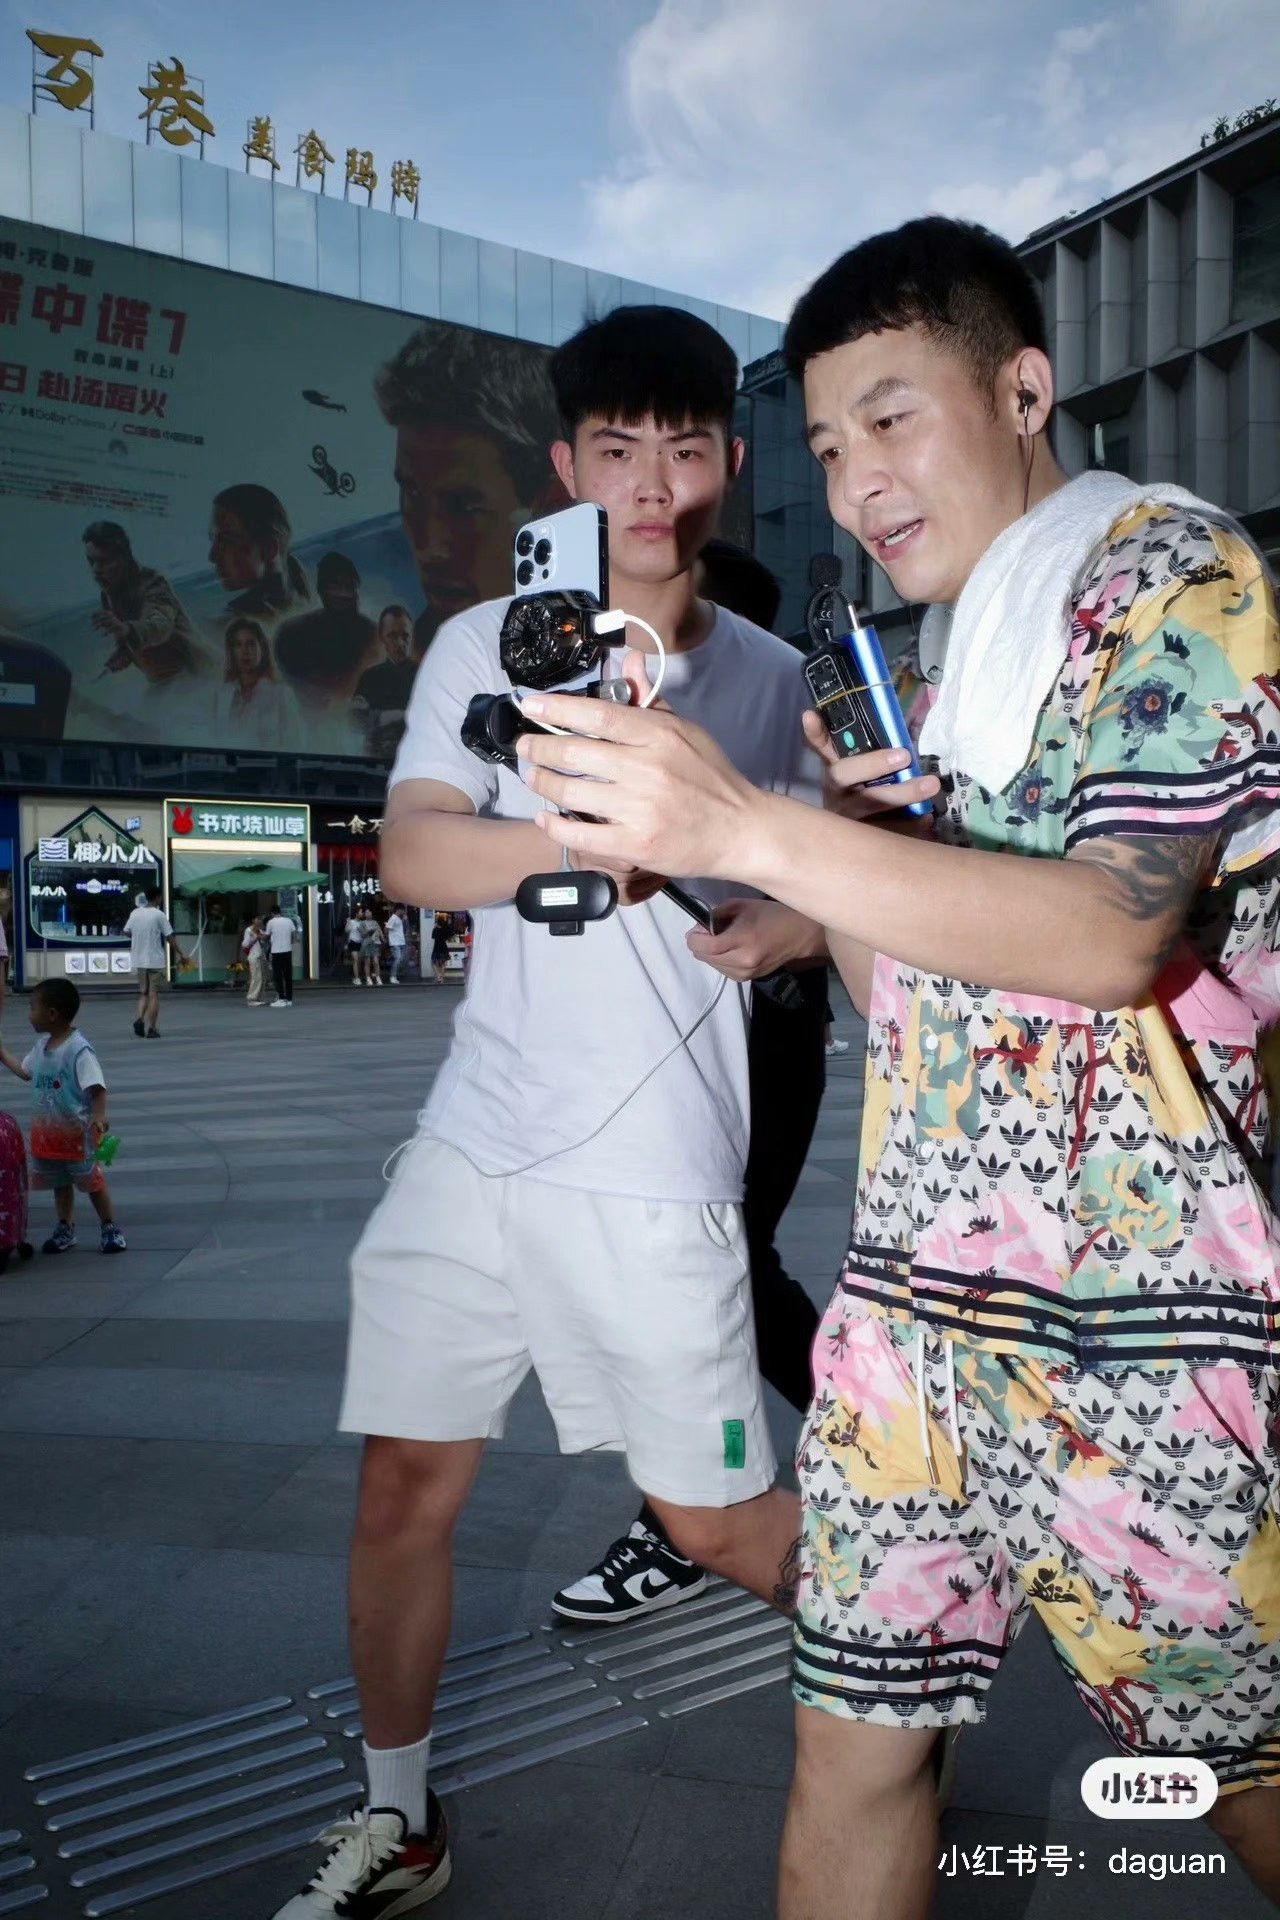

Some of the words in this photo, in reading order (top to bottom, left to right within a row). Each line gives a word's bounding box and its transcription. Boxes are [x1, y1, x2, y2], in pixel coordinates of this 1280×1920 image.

[198, 812, 305, 837] 书亦烧仙草
[73, 841, 155, 864] 椰小小
